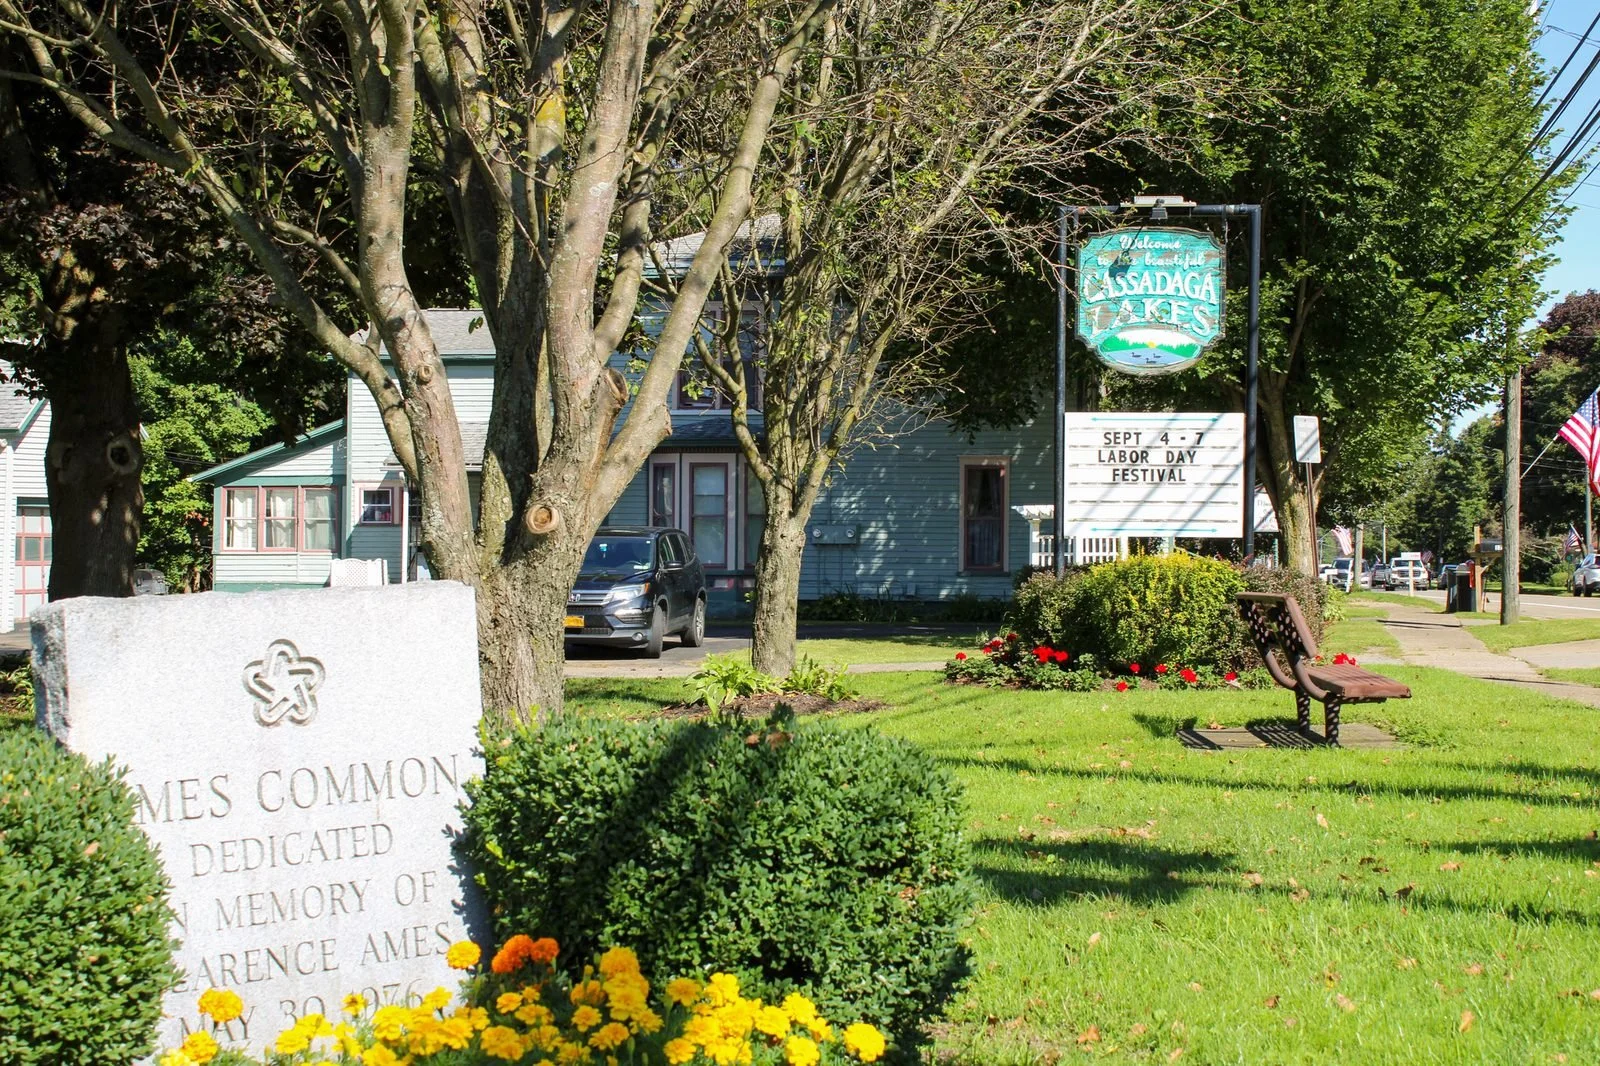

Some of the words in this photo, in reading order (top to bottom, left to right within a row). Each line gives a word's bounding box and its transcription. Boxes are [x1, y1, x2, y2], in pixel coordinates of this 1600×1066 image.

[1119, 235, 1182, 250] Welcome
[1144, 252, 1206, 270] beautiful
[1083, 271, 1217, 305] CASSADAGA
[1086, 299, 1212, 338] LAKES
[1098, 450, 1149, 463] LABOR
[1166, 450, 1197, 463] DAY
[1103, 432, 1142, 445] SEPT
[1112, 468, 1187, 482] FESTIVAL
[135, 773, 233, 825] MES
[256, 753, 459, 813] COMMON
[189, 822, 394, 878] DEDICATED
[215, 878, 372, 932] MEMORY
[394, 870, 438, 907] OF
[171, 938, 340, 993] ARENCE
[360, 921, 452, 966] AMES
[351, 978, 424, 1021] 976
